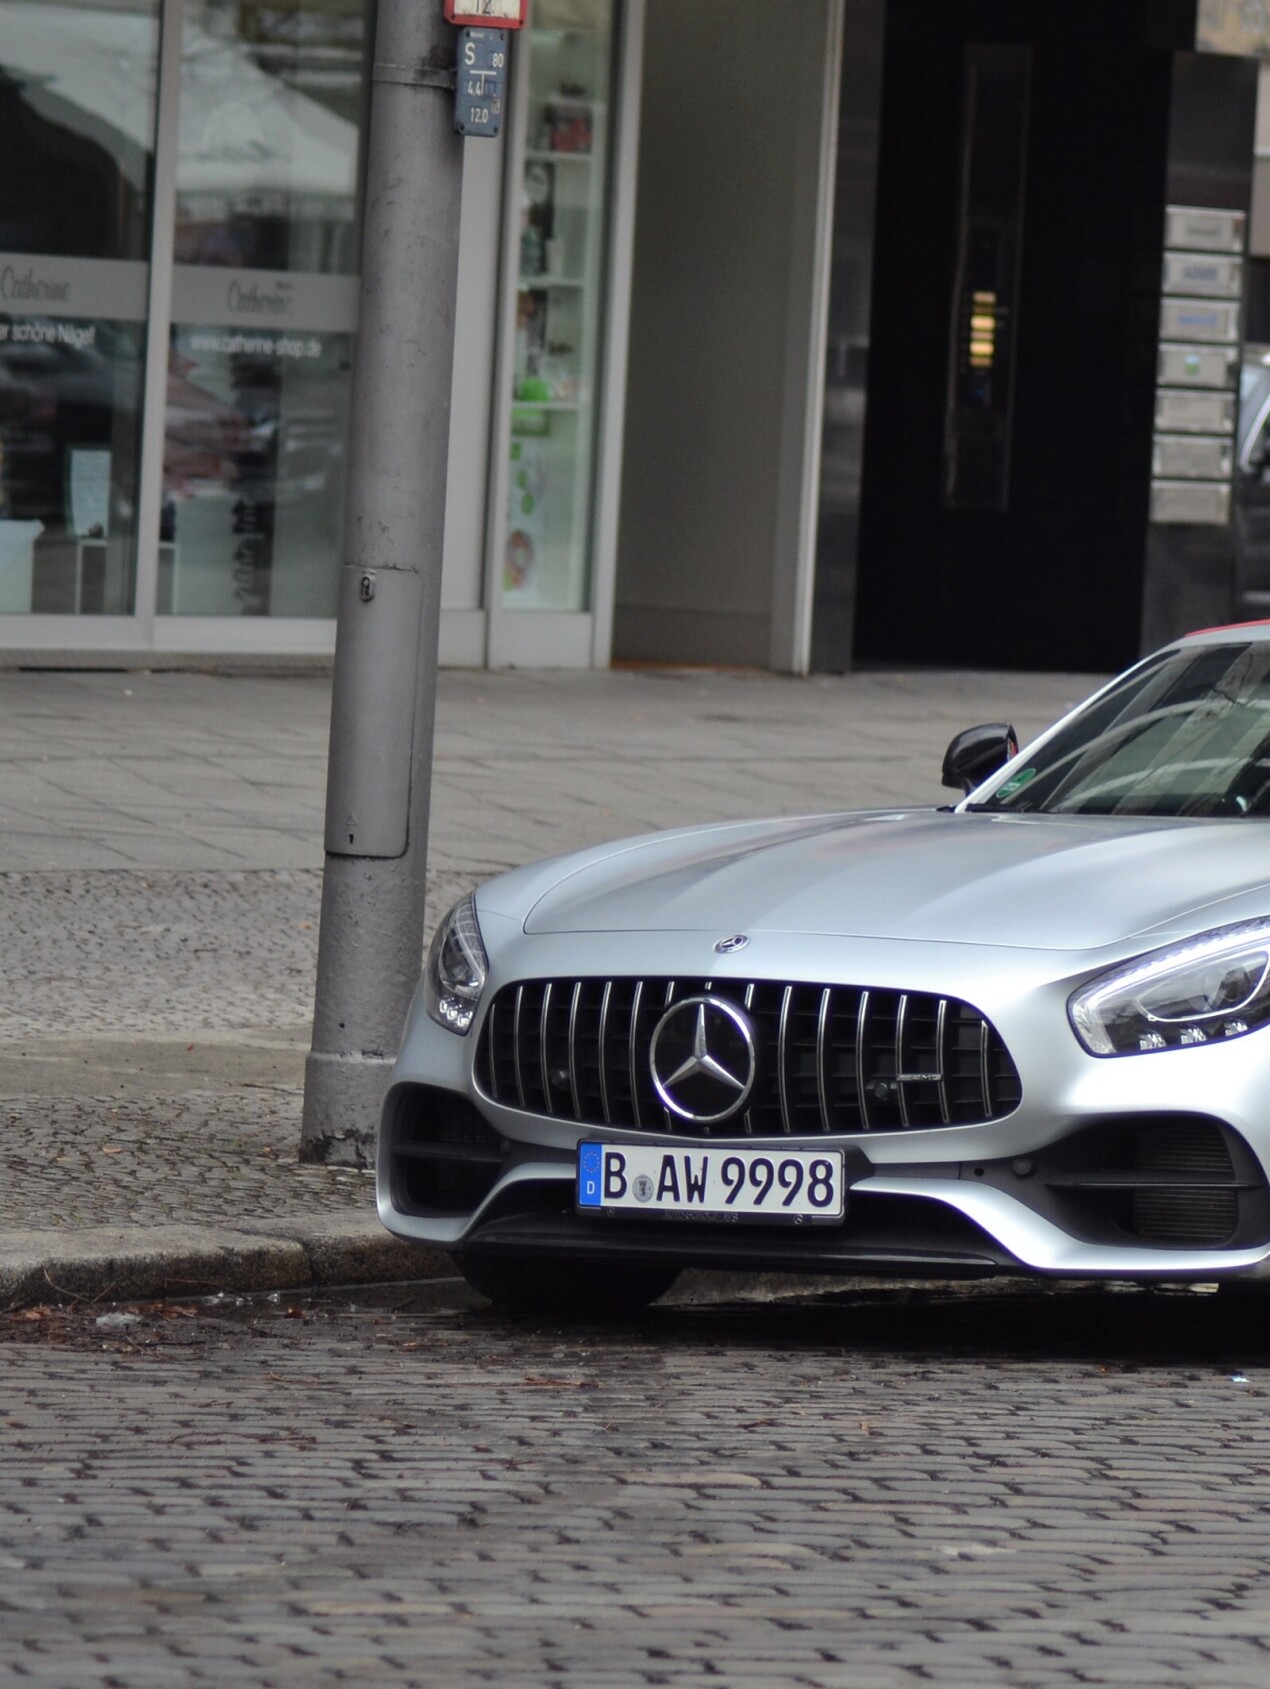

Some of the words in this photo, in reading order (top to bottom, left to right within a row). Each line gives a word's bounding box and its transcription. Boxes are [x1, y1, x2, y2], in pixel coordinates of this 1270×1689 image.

[464, 42, 476, 65] S
[492, 53, 504, 68] 80
[586, 1180, 595, 1195] D
[604, 1152, 627, 1199] B
[656, 1154, 709, 1203] AW
[721, 1156, 834, 1208] 9998
